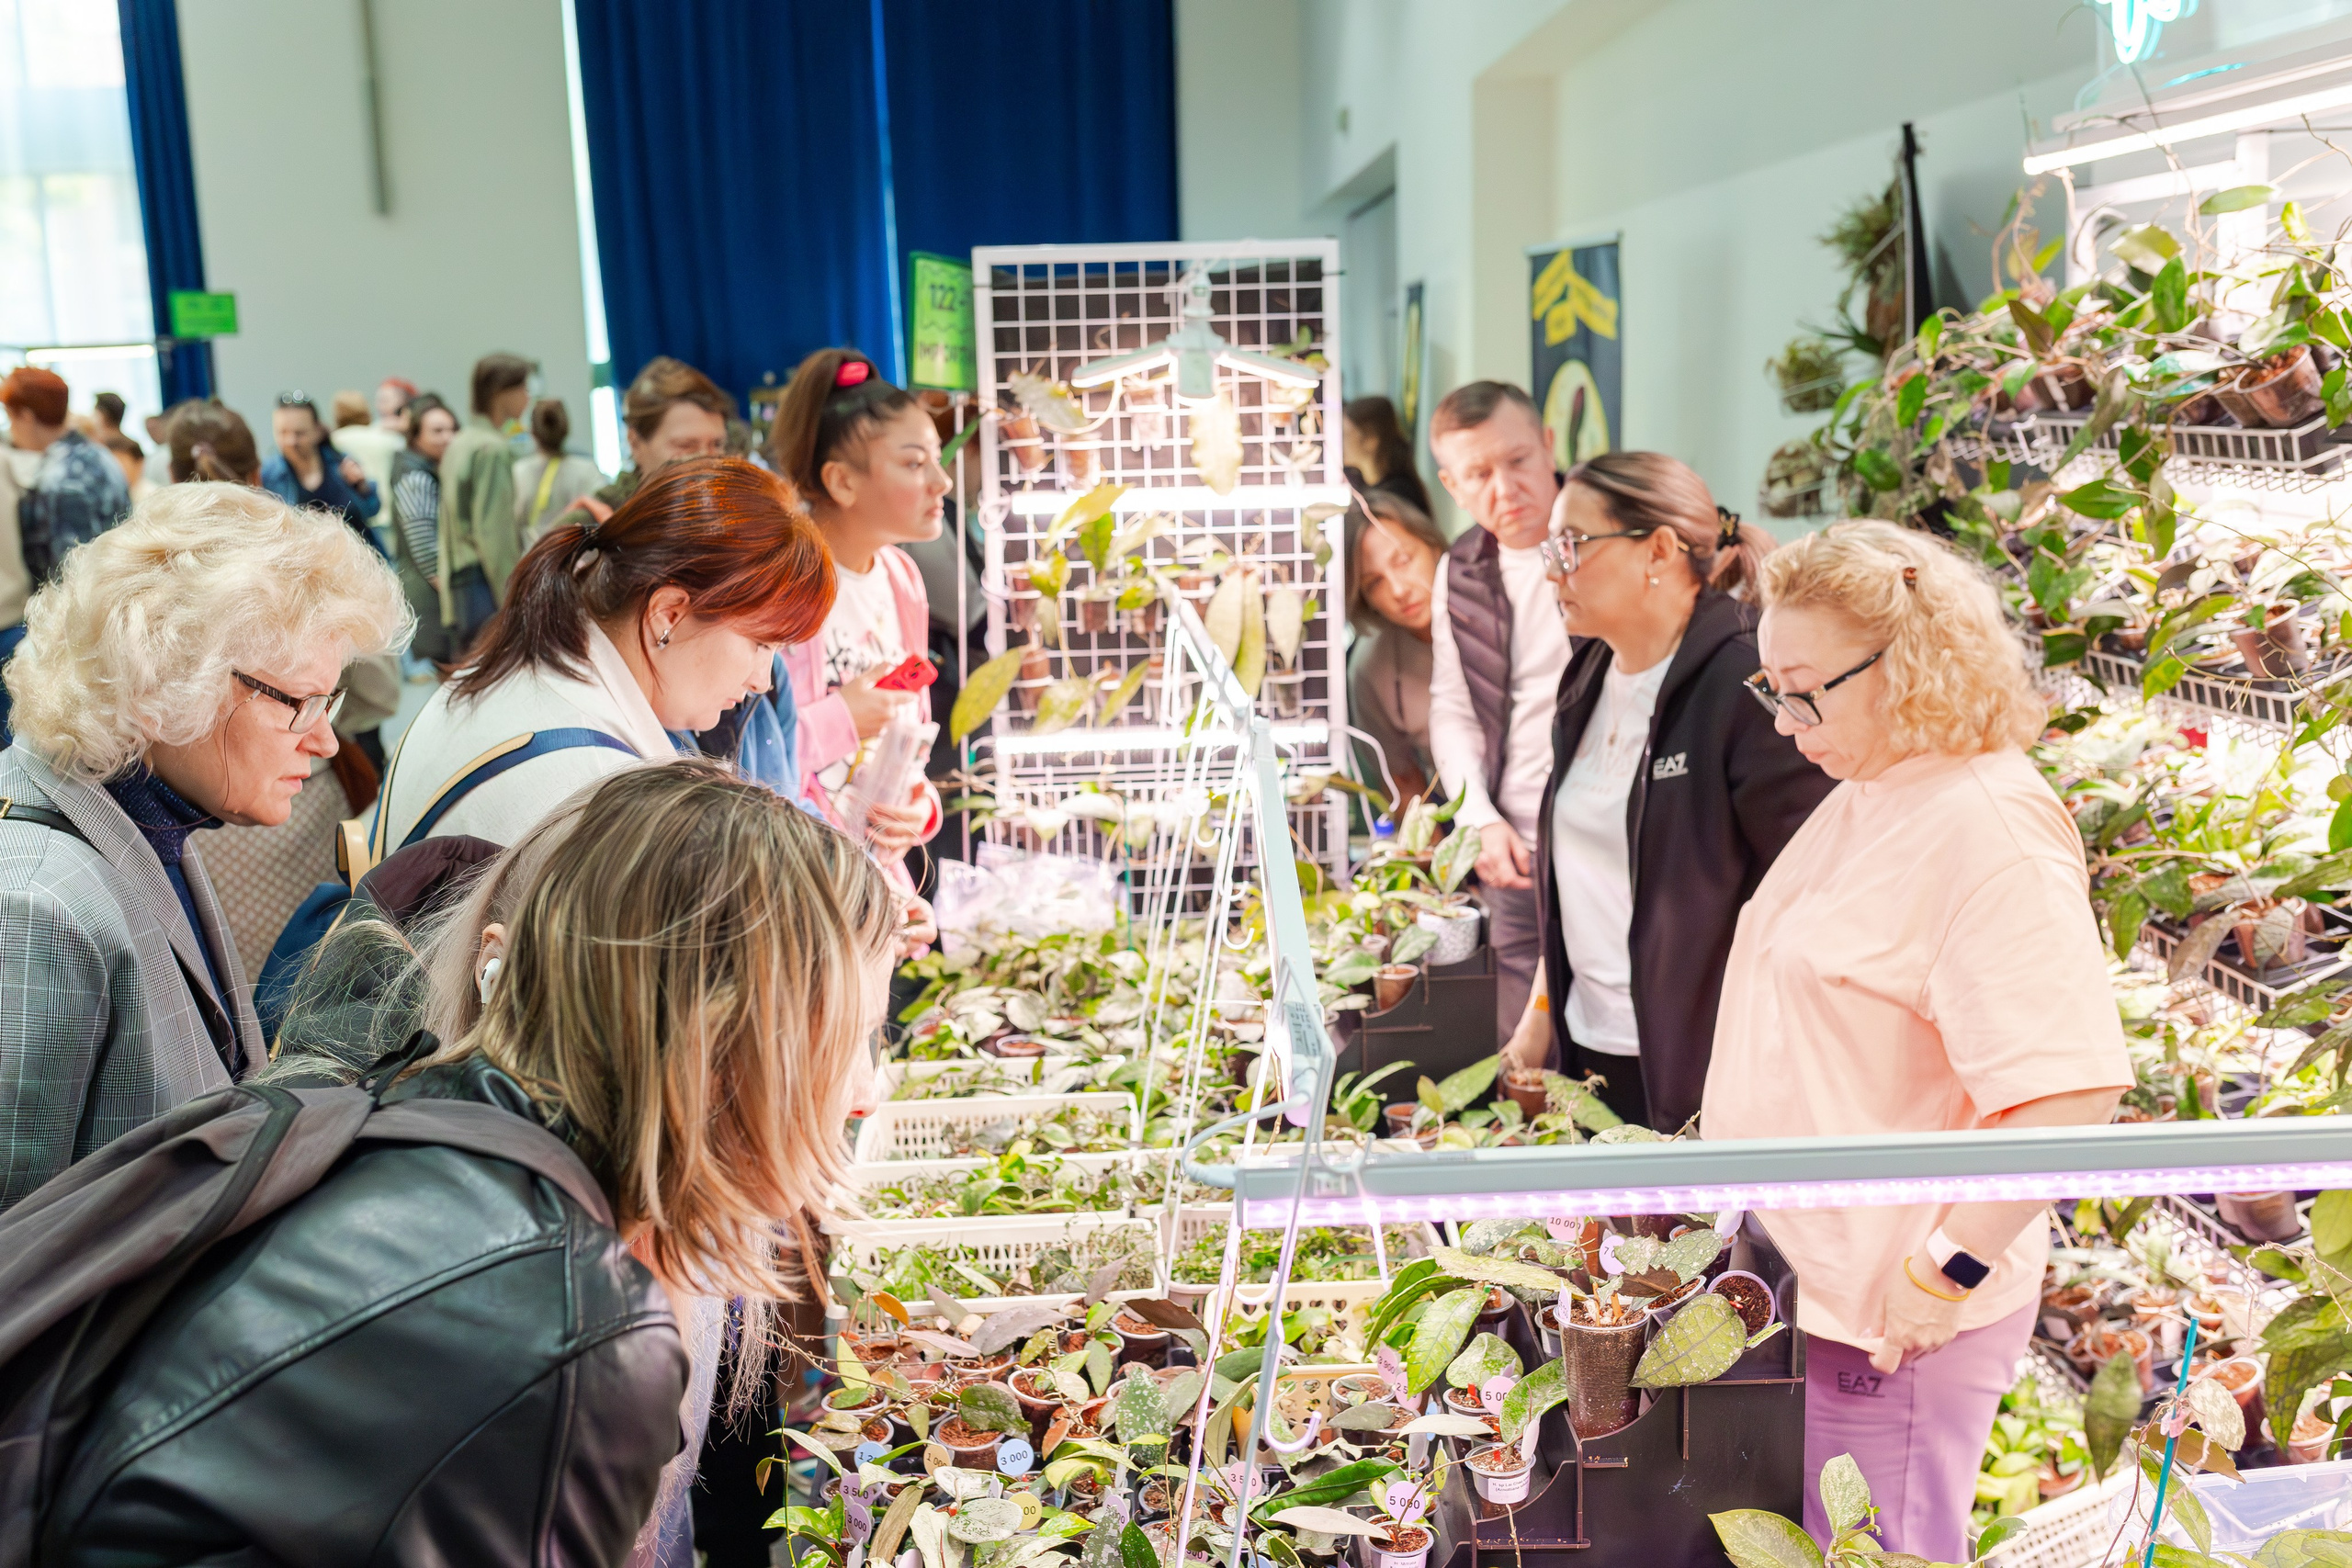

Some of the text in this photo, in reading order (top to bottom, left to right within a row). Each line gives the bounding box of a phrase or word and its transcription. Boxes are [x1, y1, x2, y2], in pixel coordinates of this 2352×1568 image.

[1653, 751, 1688, 775] EA7
[1550, 1216, 1561, 1226] 10
[1838, 1371, 1882, 1393] EA7
[1485, 1391, 1492, 1401] 5
[858, 1451, 864, 1461] 1
[927, 1452, 932, 1462] 1
[1000, 1450, 1028, 1466] 3 000
[1230, 1472, 1257, 1487] 3 50
[842, 1484, 849, 1495] 3
[1389, 1495, 1396, 1506] 5
[847, 1514, 867, 1532] 3 000
